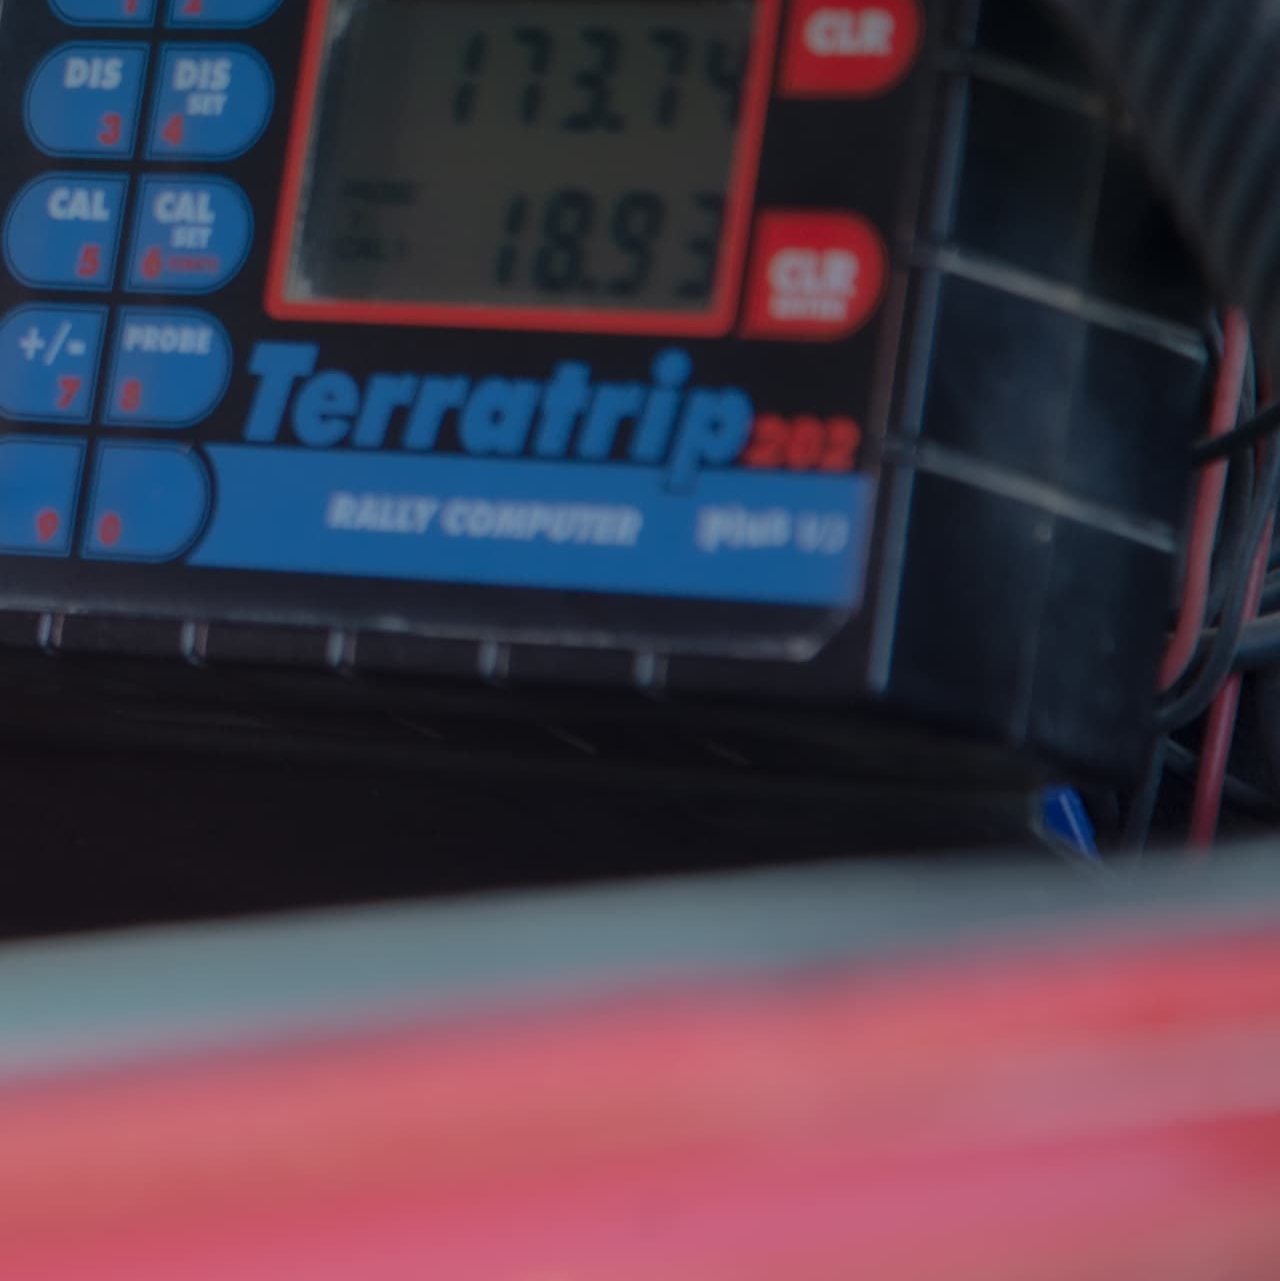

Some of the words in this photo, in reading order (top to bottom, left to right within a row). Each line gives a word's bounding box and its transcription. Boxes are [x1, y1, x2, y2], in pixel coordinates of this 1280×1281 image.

[806, 8, 894, 56] CLR
[66, 58, 122, 88] DIS
[175, 60, 230, 90] DIS
[187, 96, 227, 115] SET
[100, 116, 120, 144] 3
[163, 116, 183, 144] 4
[48, 189, 109, 220] CAL
[155, 192, 213, 223] CAL
[78, 246, 99, 276] 5
[144, 248, 161, 277] 6
[769, 248, 857, 296] CLR
[124, 326, 212, 354] PROBE
[58, 378, 80, 409] 7
[245, 342, 753, 492] Terratrip
[741, 415, 859, 470] 202
[37, 511, 57, 541] 9
[100, 514, 120, 544] 0
[328, 493, 437, 533] RALLY
[442, 499, 641, 544] COMPUTER
